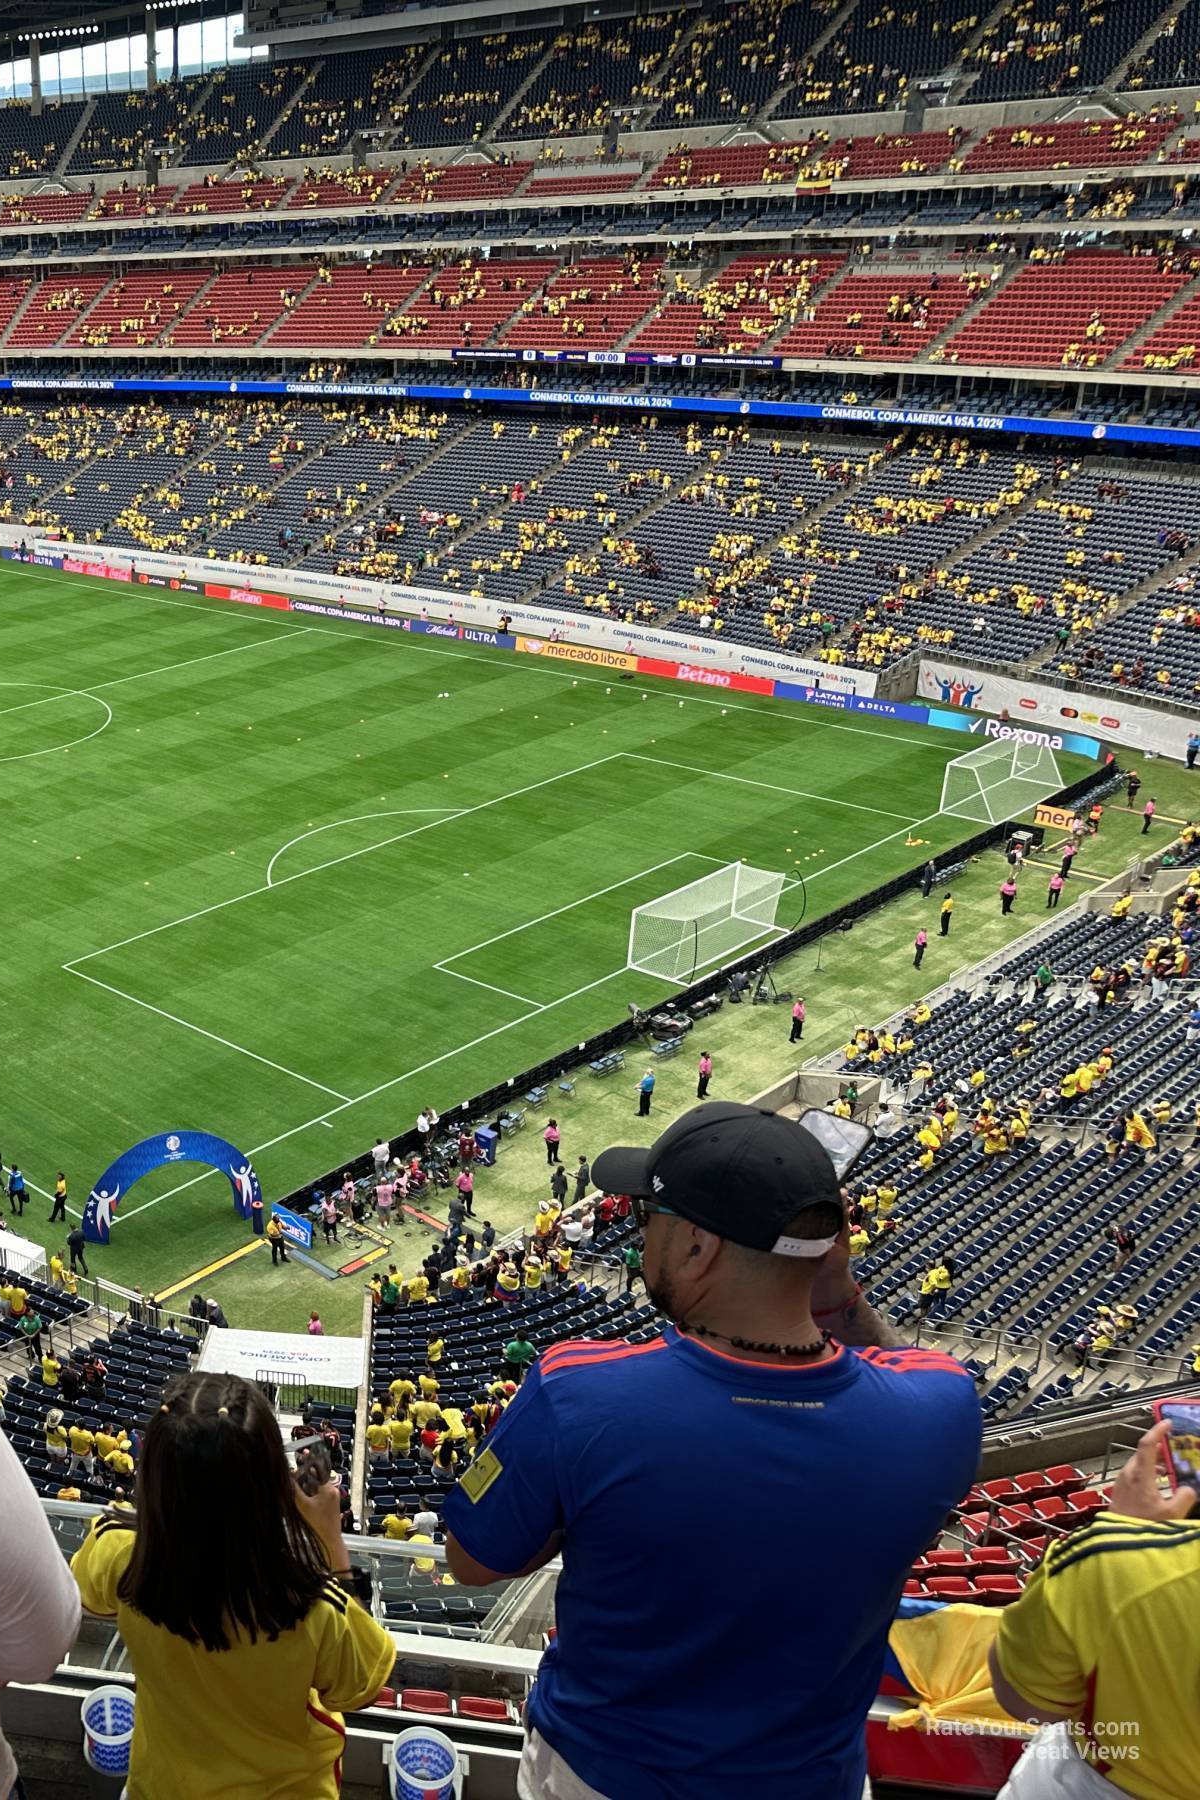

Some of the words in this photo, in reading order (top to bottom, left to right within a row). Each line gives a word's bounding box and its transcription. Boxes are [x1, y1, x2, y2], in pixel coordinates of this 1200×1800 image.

[11, 380, 45, 388] CONMEBOL
[44, 380, 61, 388] COPA
[60, 380, 88, 388] AMERICA
[87, 381, 100, 389] USA
[99, 381, 114, 389] 2024
[286, 384, 324, 393] CONMEBOL
[323, 385, 341, 393] COPA
[340, 385, 373, 394] AMERICA
[374, 386, 388, 395] USA
[388, 387, 406, 396] 2024
[529, 391, 574, 403] CONMEBOL
[574, 394, 596, 404] COPA
[595, 395, 633, 406] AMERICA
[634, 396, 650, 407] USA
[651, 397, 672, 408] 2024
[821, 407, 878, 421] CONMEBOL
[877, 410, 906, 423] COPA
[905, 412, 953, 427] AMERICA
[954, 415, 975, 428] USA
[976, 416, 1004, 429] 2024
[33, 556, 53, 566] ULTRA
[230, 588, 263, 605] Betano
[294, 601, 327, 614] CONMEBOL
[327, 606, 344, 617] COPA
[343, 610, 371, 623] AMERICA
[371, 614, 384, 624] USA
[384, 617, 401, 627] 2024
[496, 608, 526, 619] CONMEBOL
[526, 613, 541, 621] COPA
[541, 615, 565, 626] AMERICA
[565, 619, 576, 628] USA
[576, 621, 591, 630] 2024
[464, 630, 498, 645] ULTRA
[613, 629, 645, 641] CONMEBOL
[645, 635, 662, 644] COPA
[661, 639, 688, 649] AMERICA
[688, 644, 700, 652] USA
[701, 646, 716, 655] 2024
[547, 645, 599, 662] mercado
[600, 652, 627, 667] libre
[676, 664, 731, 687] Betano
[741, 654, 777, 669] CONMEBOL
[776, 662, 795, 672] COPA
[794, 666, 825, 679] AMERICA
[825, 672, 839, 682] USA
[839, 675, 857, 686] 2024
[814, 691, 846, 703] LATAM
[866, 702, 896, 714] DELTA
[984, 718, 1063, 750] Rexona
